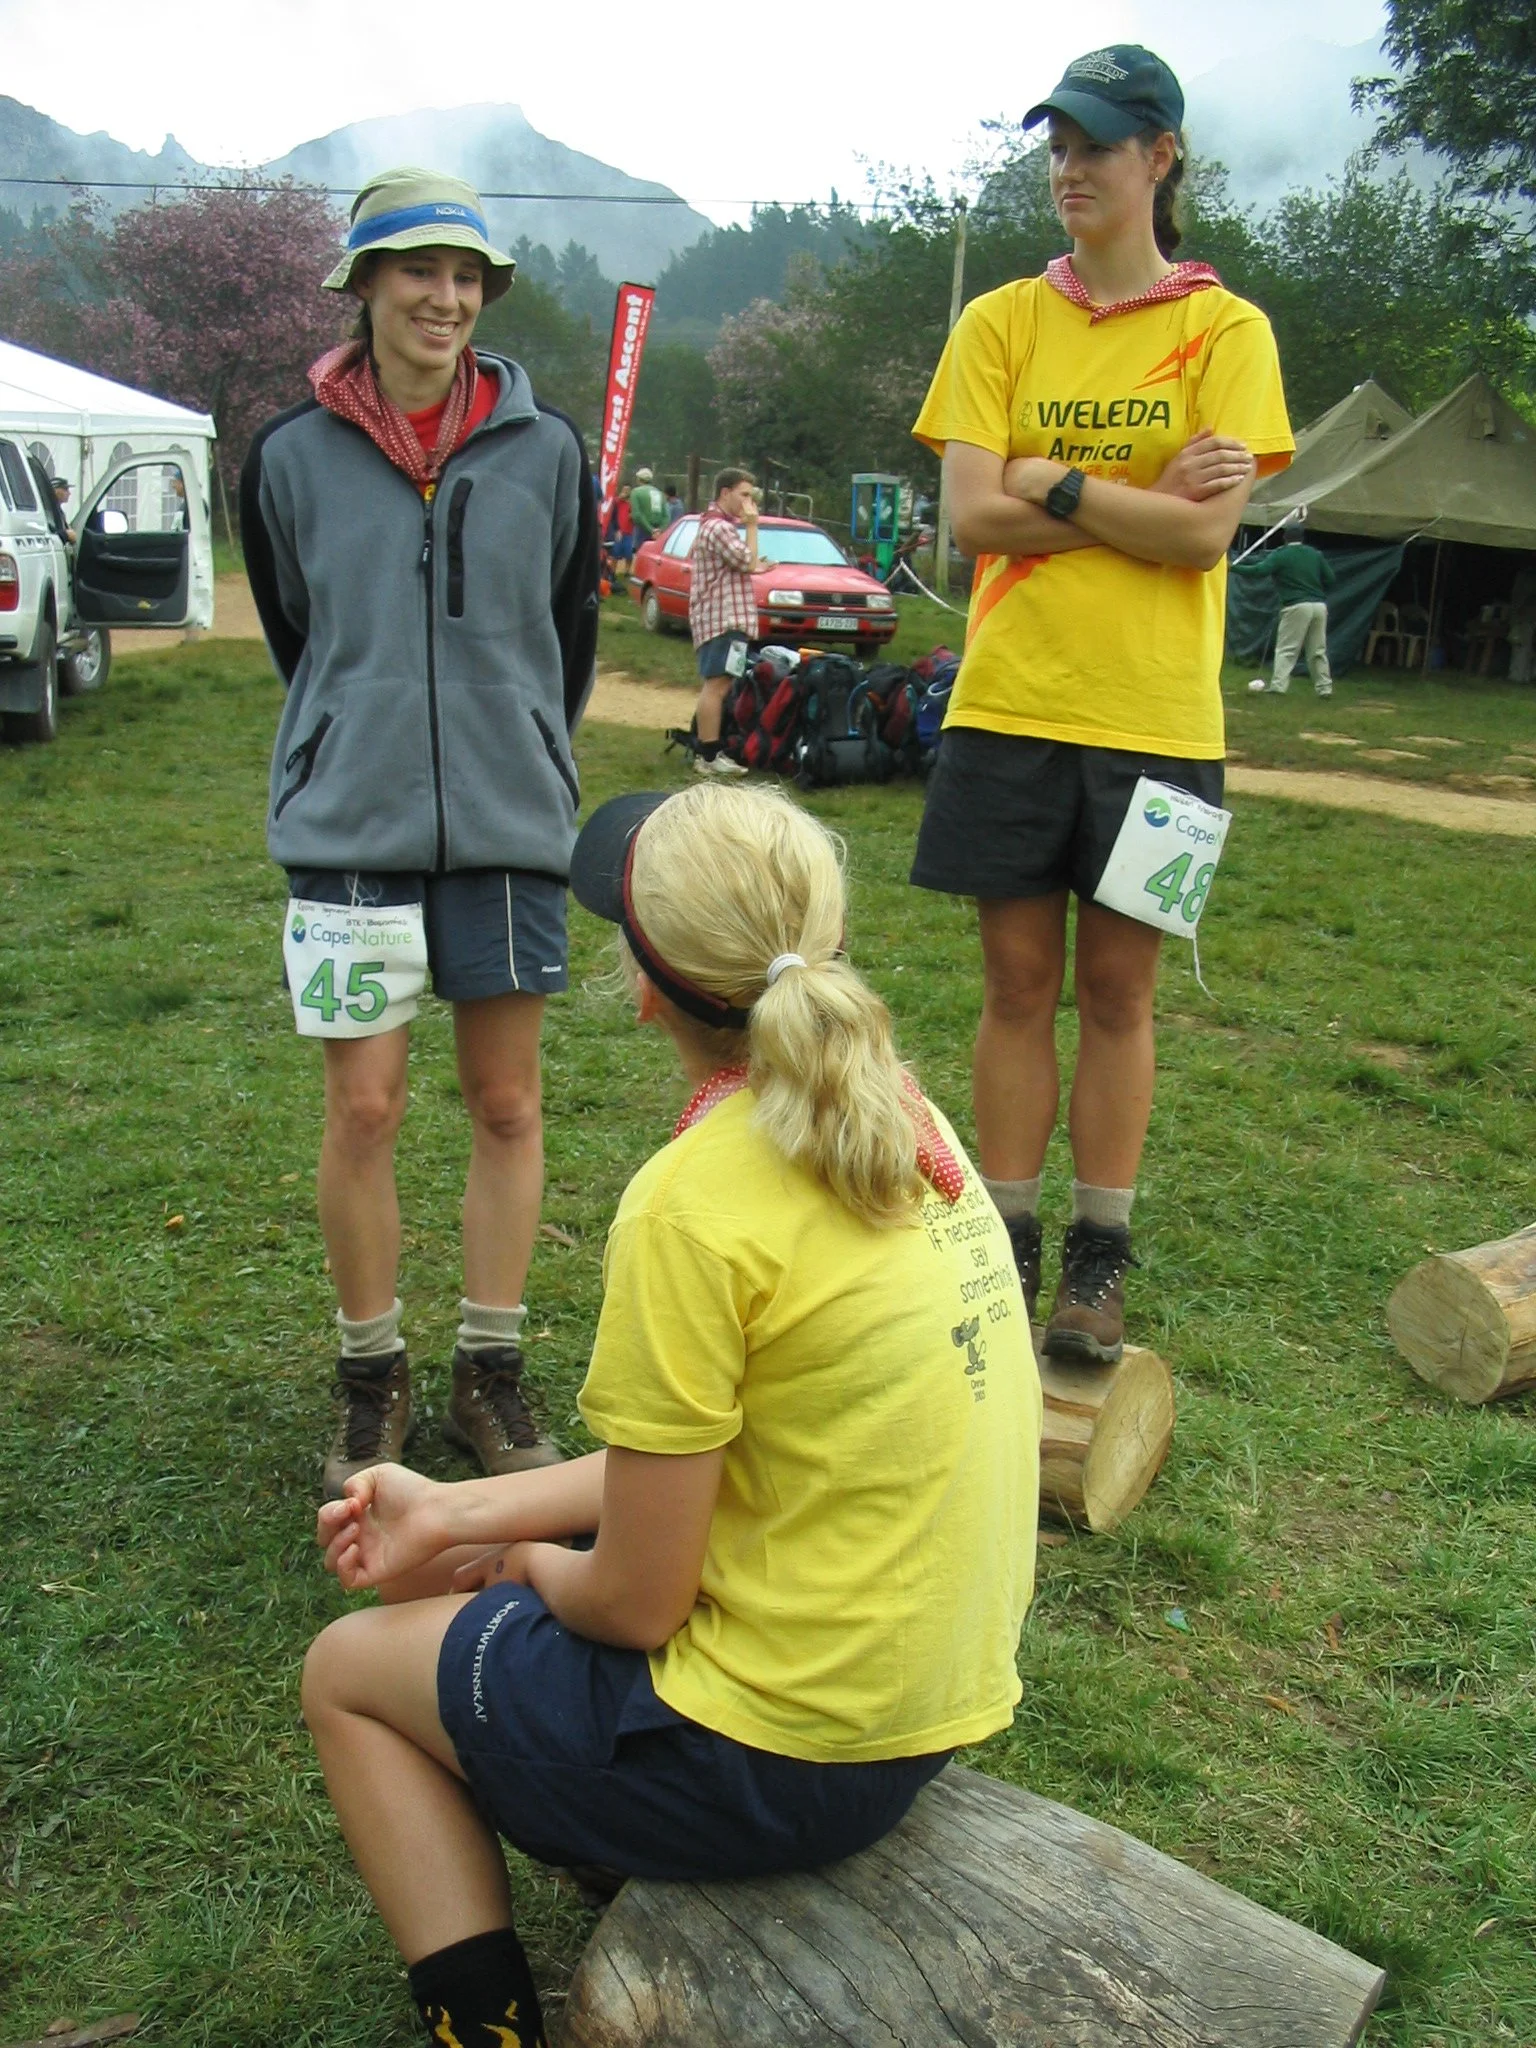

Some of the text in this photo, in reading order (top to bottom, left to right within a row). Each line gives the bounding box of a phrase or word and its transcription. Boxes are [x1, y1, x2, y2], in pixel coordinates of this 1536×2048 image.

[615, 294, 644, 389] Ascent
[1037, 399, 1170, 429] WELEDA
[1047, 437, 1133, 462] Arnica
[1144, 852, 1215, 923] 48
[310, 923, 413, 948] CapeNature
[301, 958, 388, 1022] 45
[924, 1228, 943, 1252] if
[970, 1244, 989, 1268] say
